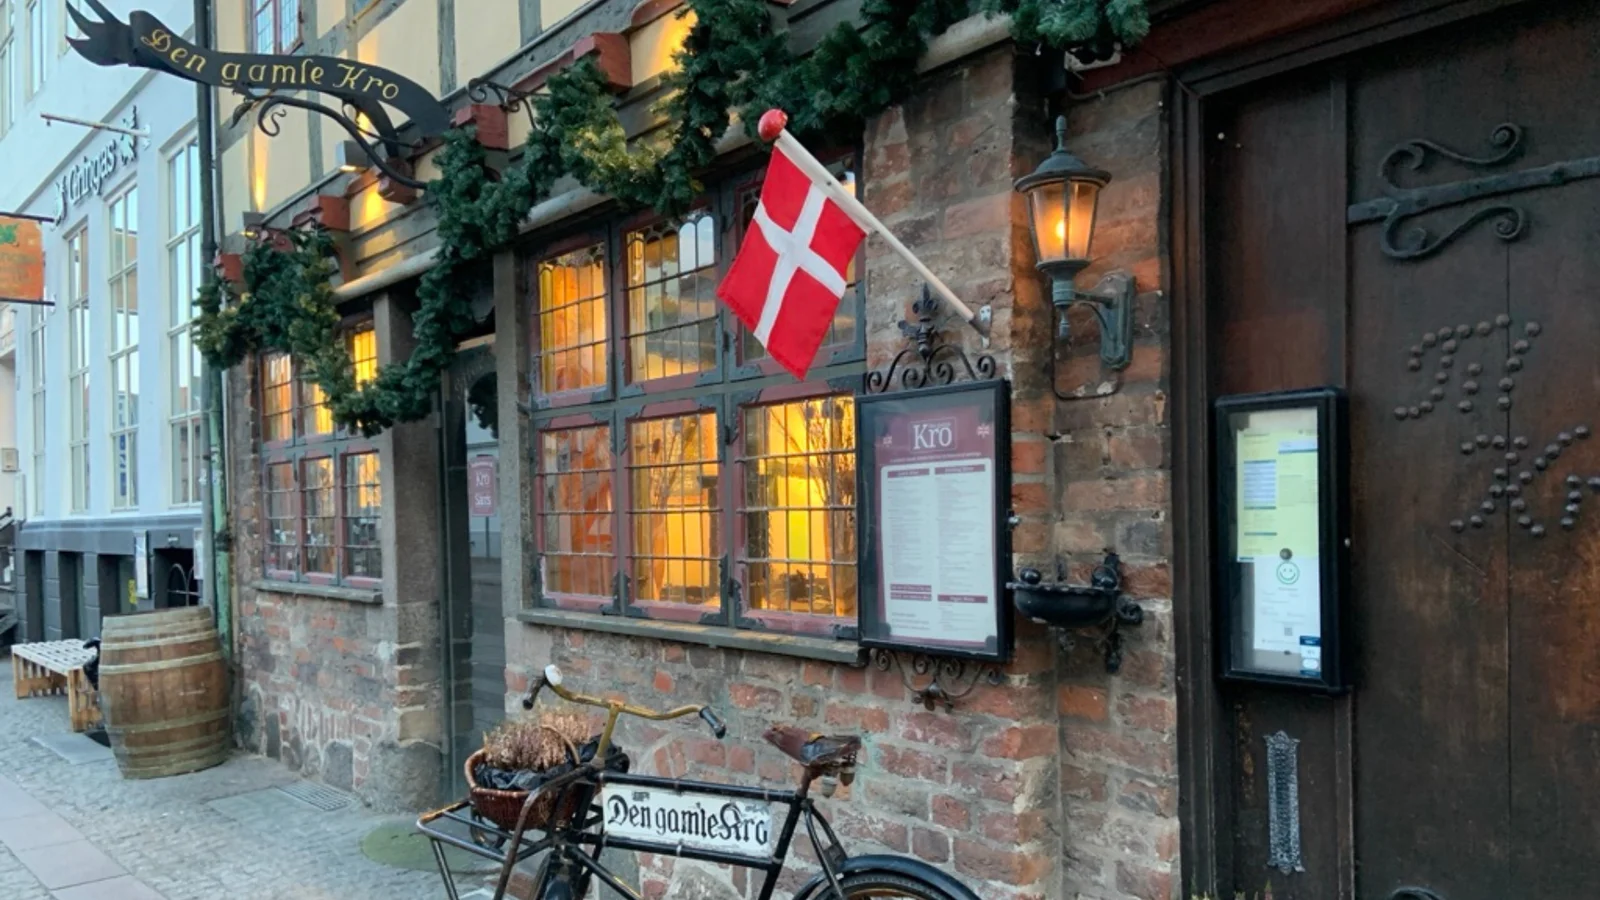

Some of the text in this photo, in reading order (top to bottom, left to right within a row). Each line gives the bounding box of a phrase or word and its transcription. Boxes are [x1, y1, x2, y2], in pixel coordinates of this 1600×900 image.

[140, 29, 399, 100] Den gamle Kro
[912, 423, 953, 450] Kro
[607, 794, 651, 829] Den
